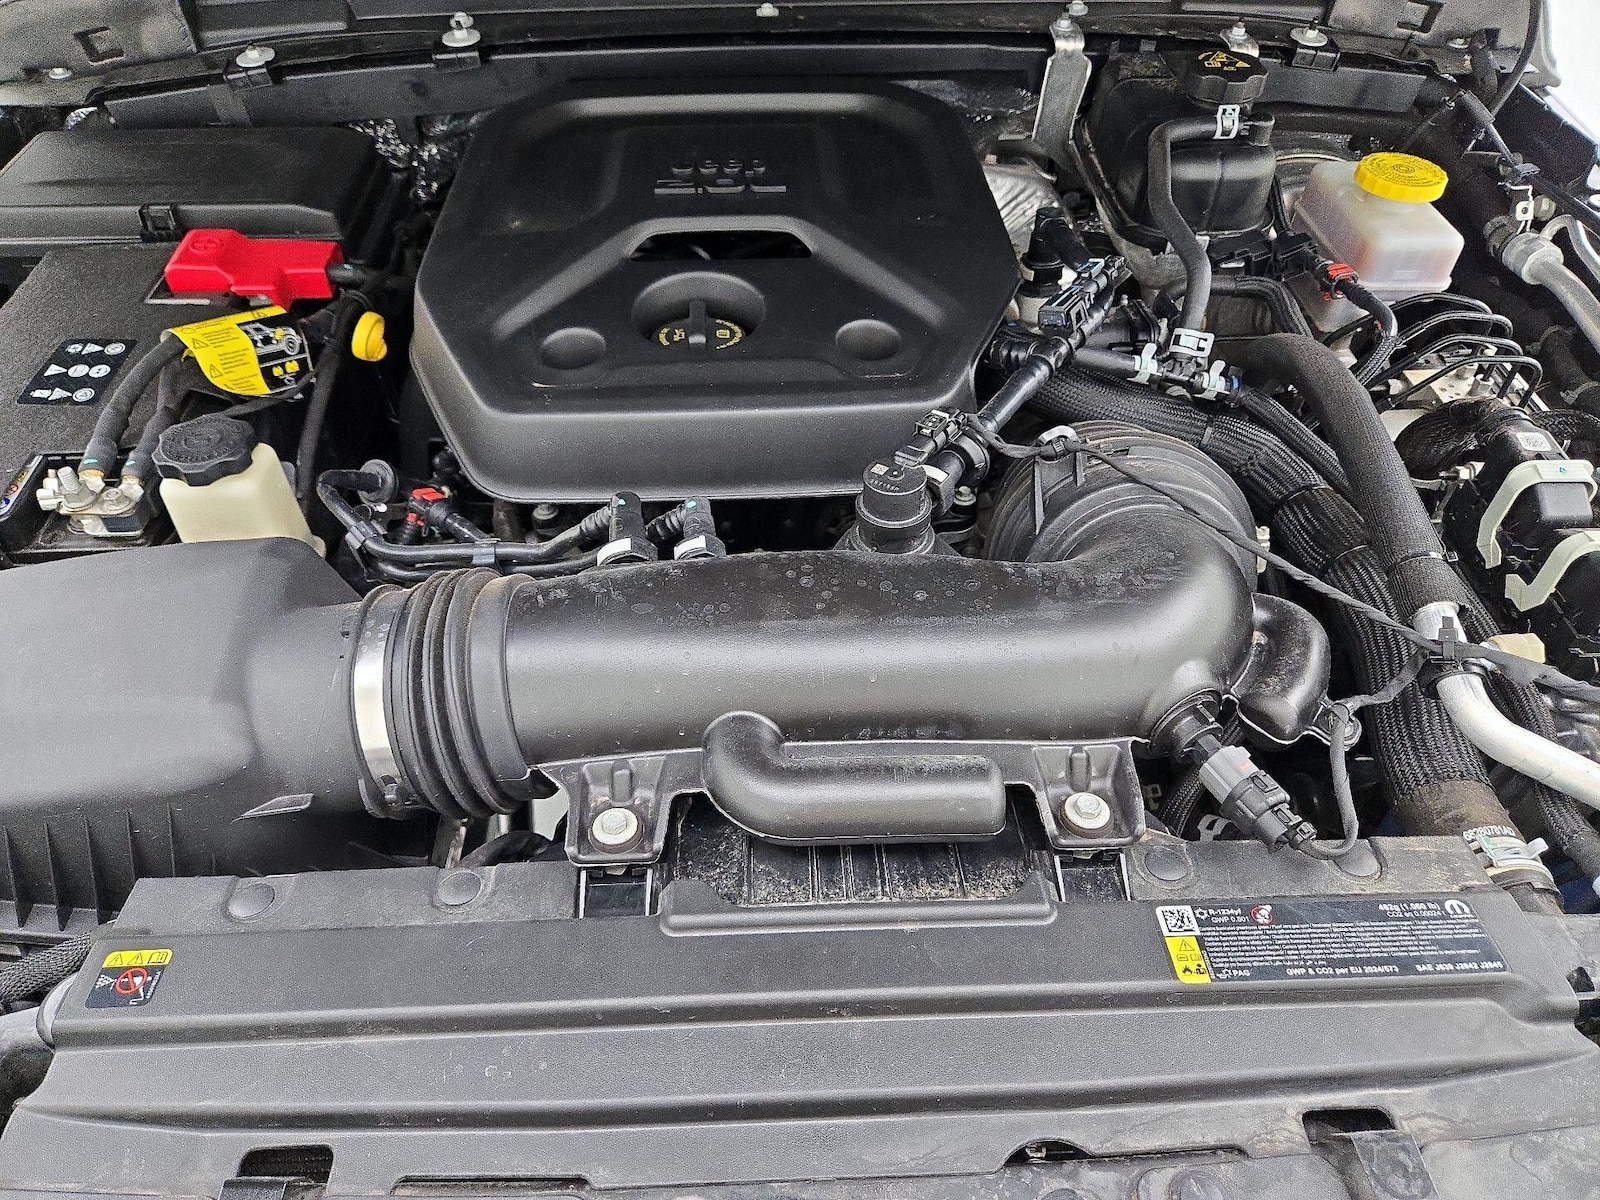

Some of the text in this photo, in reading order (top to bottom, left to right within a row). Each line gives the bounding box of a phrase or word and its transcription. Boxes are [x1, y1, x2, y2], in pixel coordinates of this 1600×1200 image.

[1211, 916, 1230, 924] GWP
[1286, 967, 1306, 976] GWP
[1307, 967, 1316, 975] &
[1315, 966, 1334, 975] CO2
[1334, 966, 1349, 976] per
[1349, 966, 1363, 974] EU
[1415, 963, 1434, 972] SAE
[1232, 969, 1251, 977] PAG
